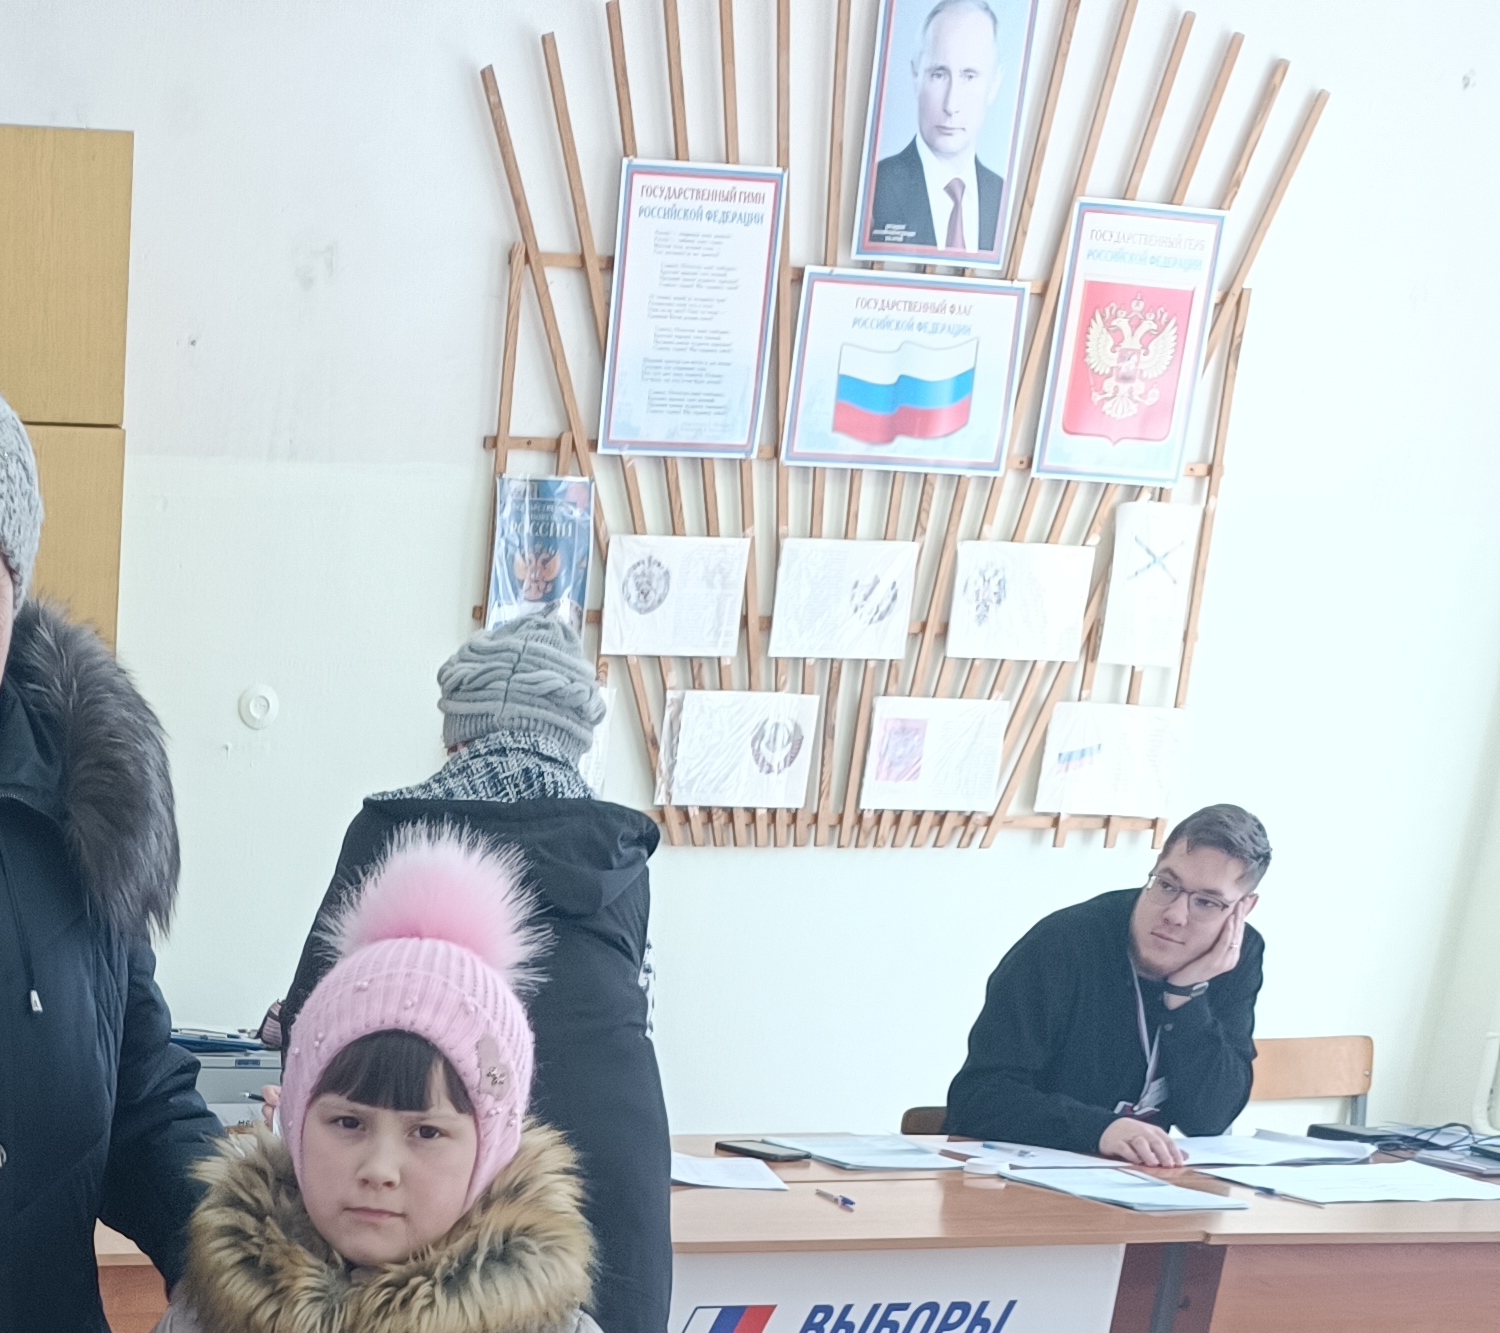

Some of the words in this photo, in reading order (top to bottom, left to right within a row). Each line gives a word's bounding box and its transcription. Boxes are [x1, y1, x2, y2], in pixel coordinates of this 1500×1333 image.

[640, 184, 737, 203] ГОСУДАРСТВЕННЫЙ
[738, 191, 766, 205] ГИМН
[638, 203, 703, 220] РОССИЙСКОЙ
[705, 211, 765, 227] ФЕДЕРАЦИИ
[855, 296, 947, 315] ГОСУДАРСТВЕННЫЙ
[851, 315, 914, 332] РОССИЙСКОЙ
